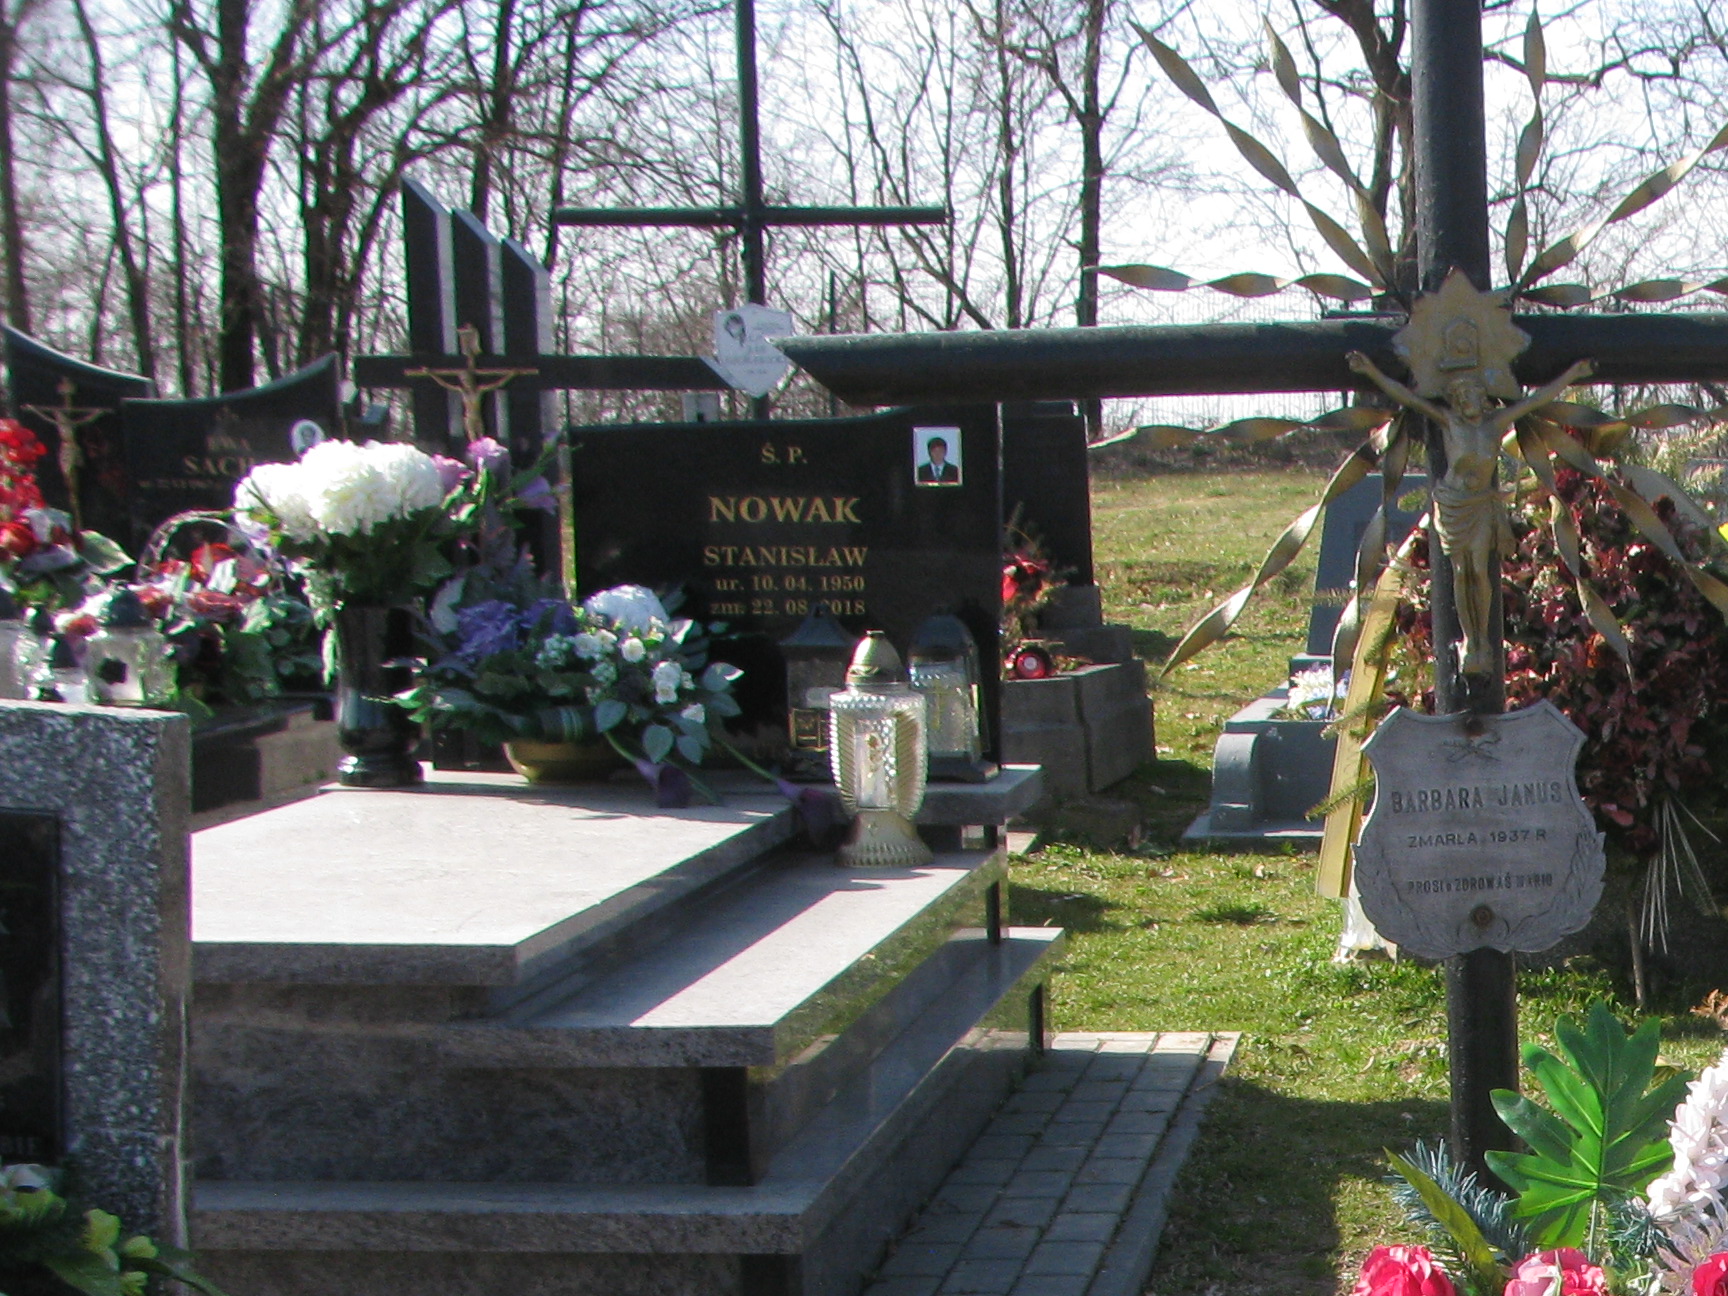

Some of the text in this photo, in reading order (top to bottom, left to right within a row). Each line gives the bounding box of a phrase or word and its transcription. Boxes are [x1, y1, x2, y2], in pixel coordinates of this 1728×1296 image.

[761, 441, 808, 464] Ś. P.
[708, 496, 862, 523] NOWAK
[715, 578, 744, 591] ur.
[820, 575, 866, 591] 1950
[822, 599, 866, 616] 018
[1391, 781, 1563, 813] BARBARA JANUS
[1490, 829, 1530, 843] 1937
[1535, 828, 1547, 841] R
